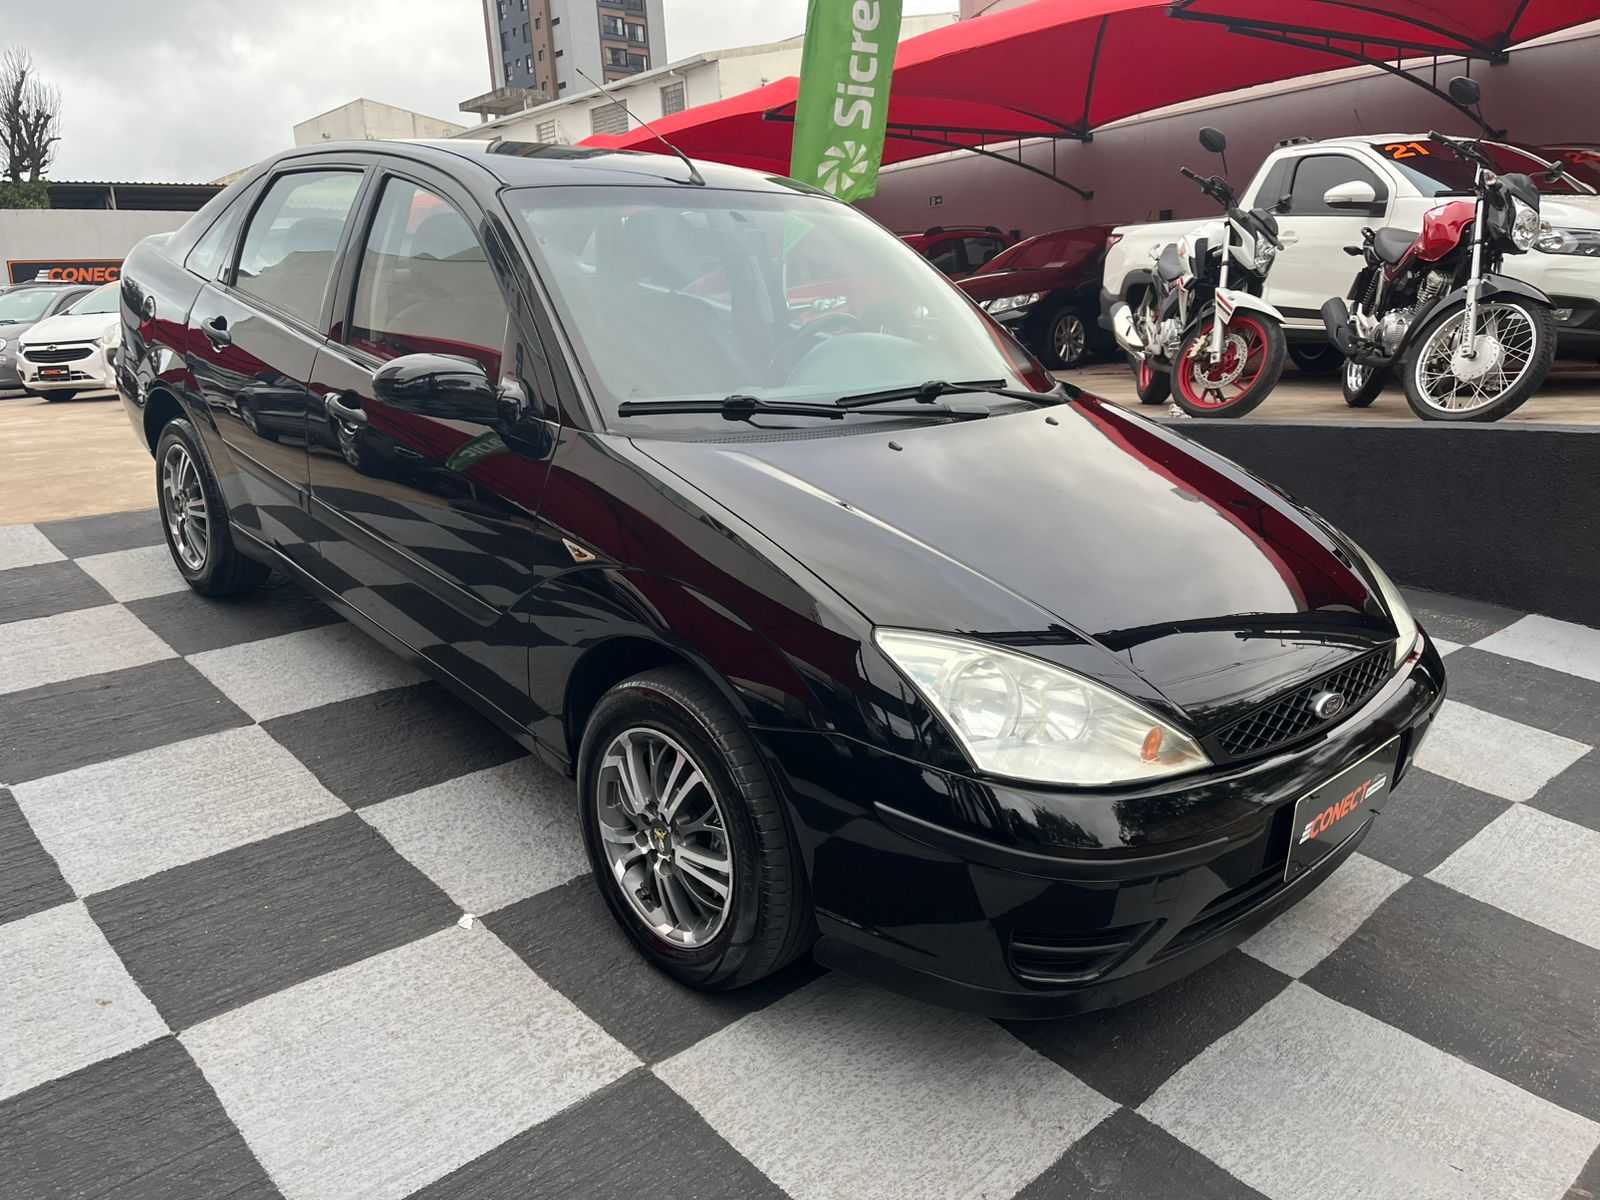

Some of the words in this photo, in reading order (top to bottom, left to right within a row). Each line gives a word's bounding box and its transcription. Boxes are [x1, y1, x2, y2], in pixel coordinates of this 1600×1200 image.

[1385, 143, 1430, 159] 21
[48, 268, 121, 283] CONEC
[1310, 779, 1371, 839] CONECT
